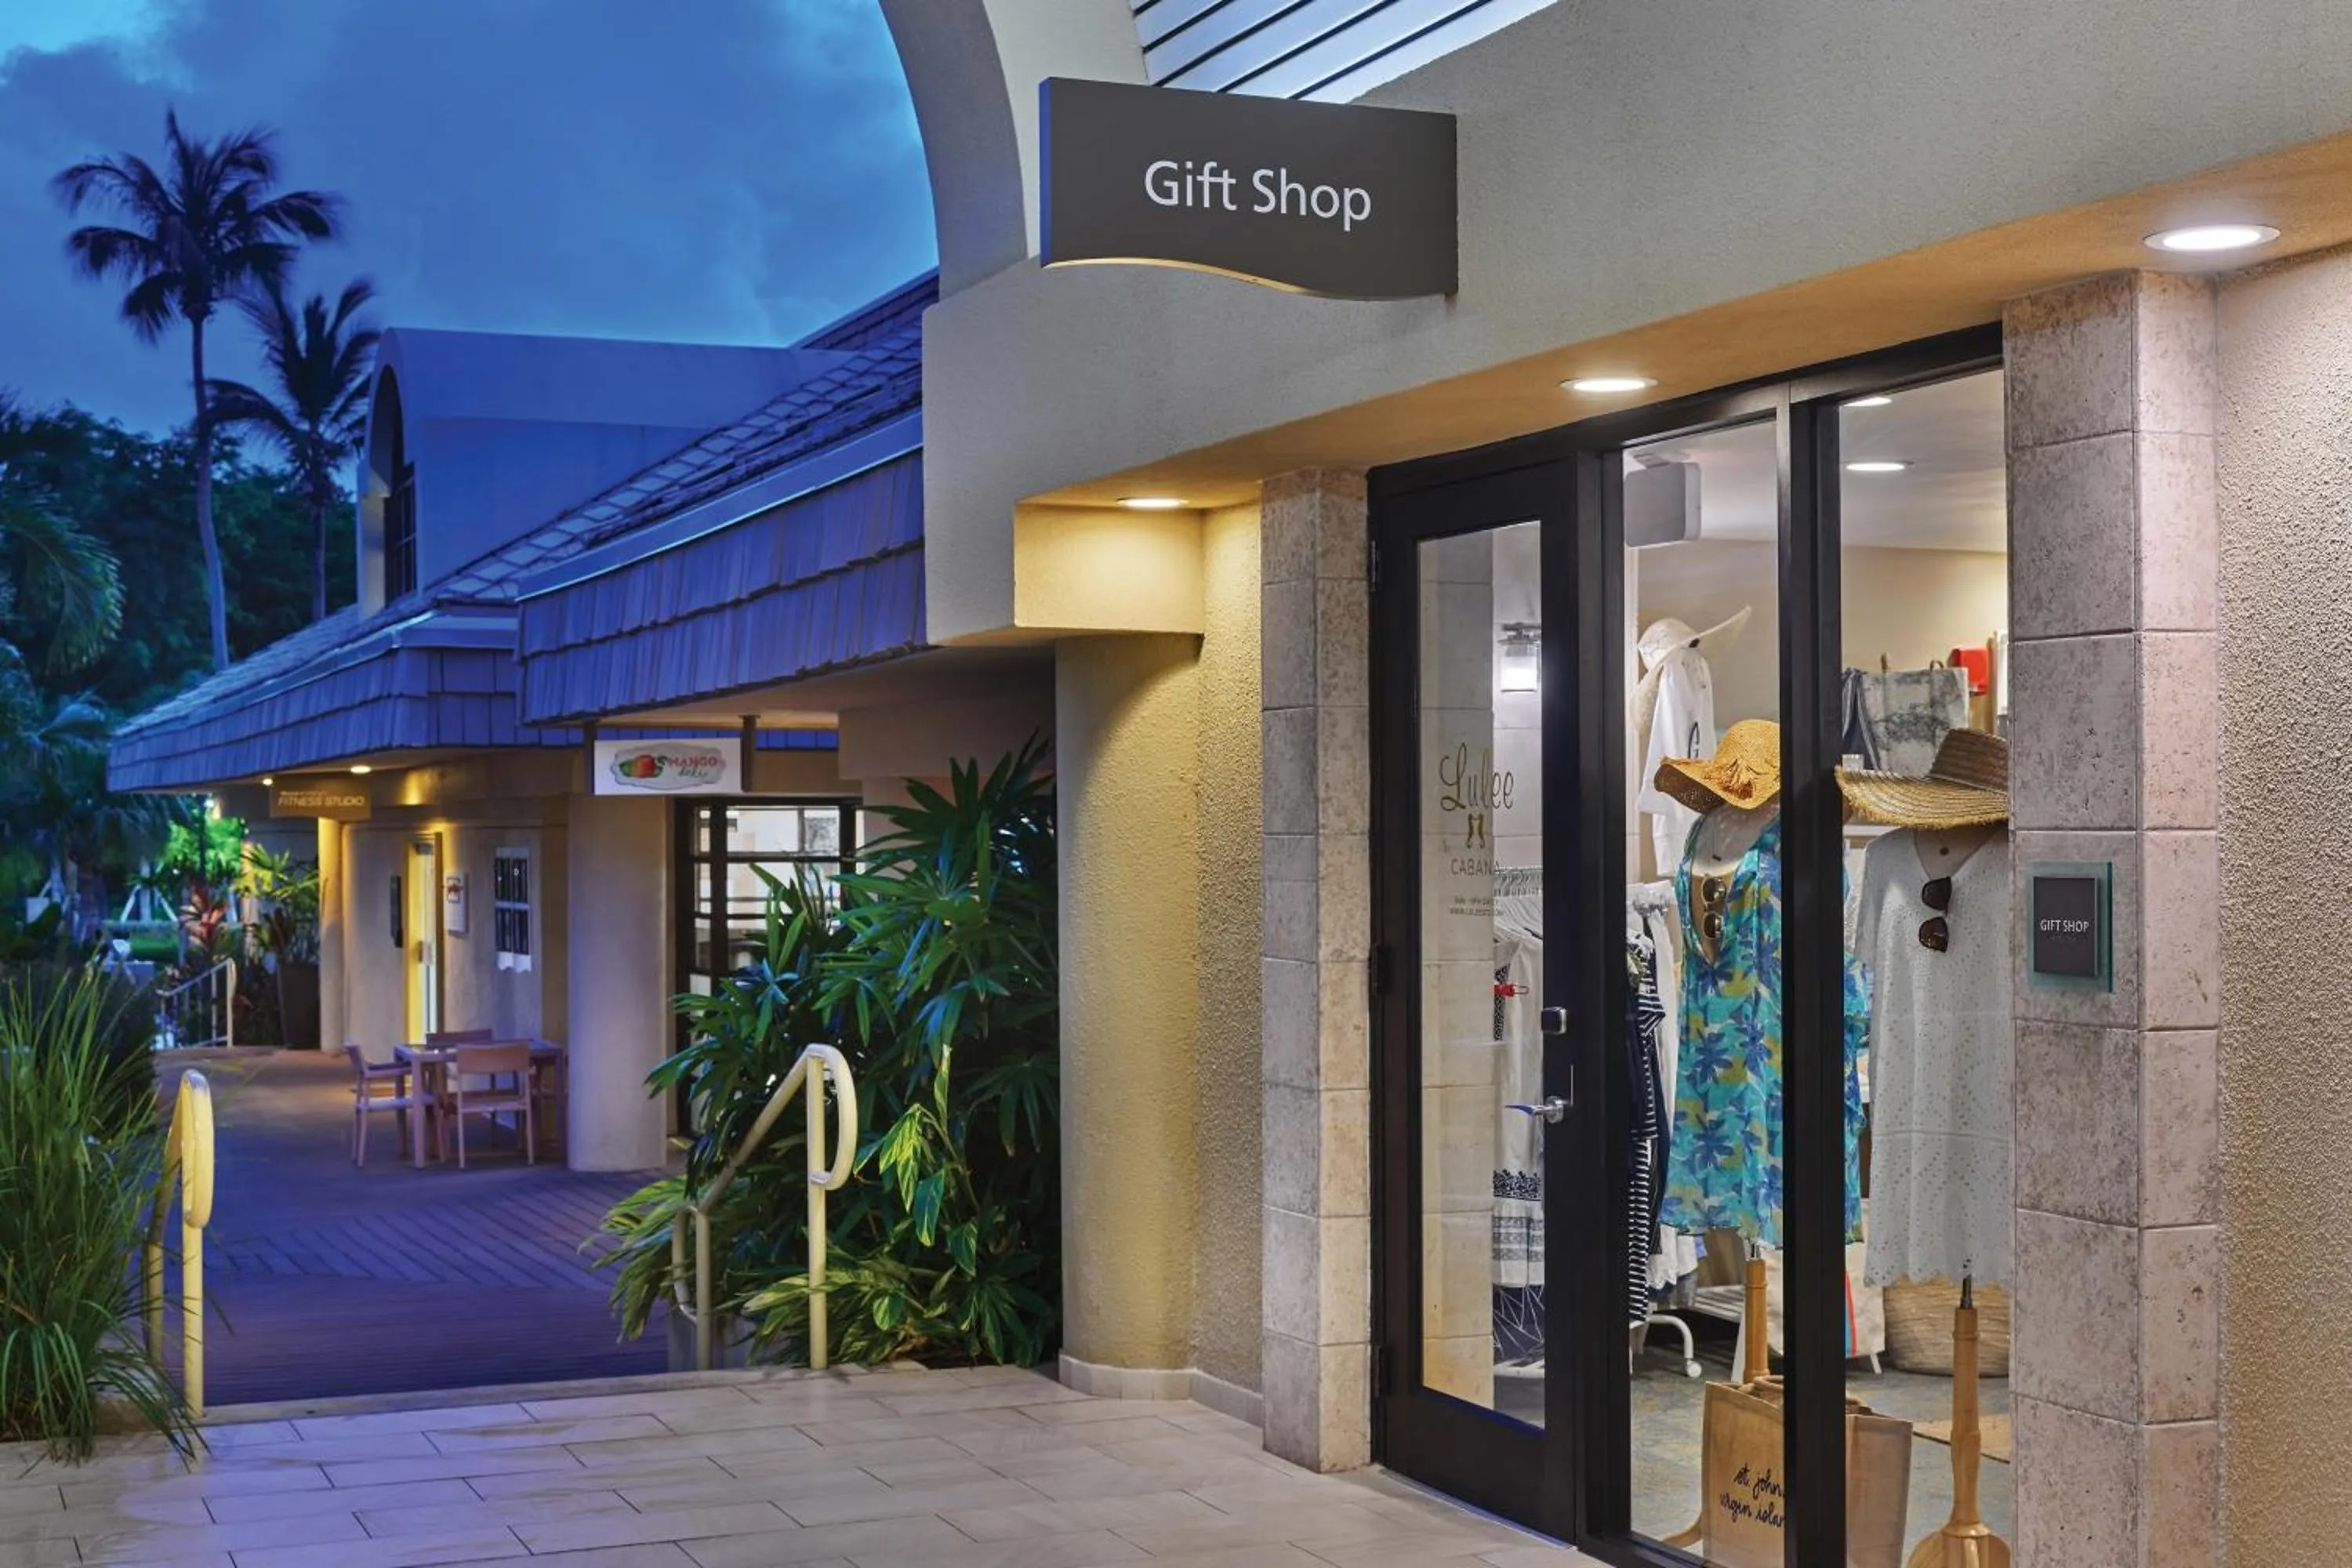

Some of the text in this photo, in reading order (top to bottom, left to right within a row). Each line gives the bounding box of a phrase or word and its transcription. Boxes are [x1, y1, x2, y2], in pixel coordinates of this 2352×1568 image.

[1144, 160, 1372, 231] Gift Shop
[669, 755, 718, 768] MANGO
[1439, 742, 1514, 812] Lulee
[278, 795, 365, 807] FITNESS STUDIO
[2040, 920, 2089, 932] GIFT SHOP
